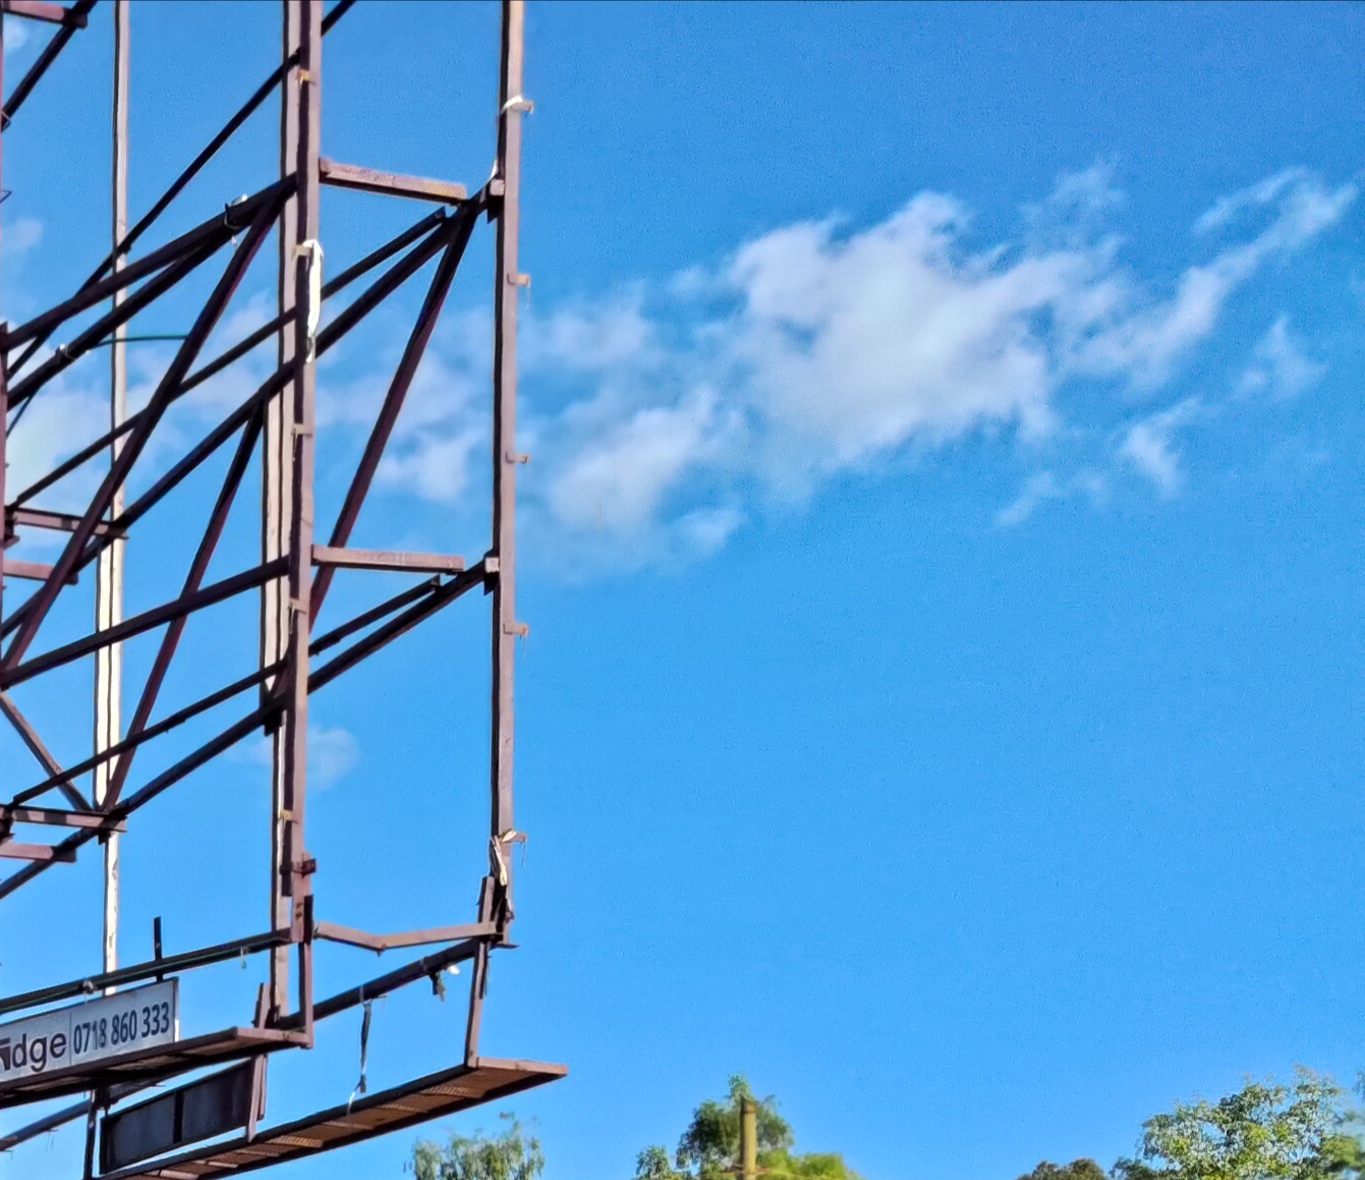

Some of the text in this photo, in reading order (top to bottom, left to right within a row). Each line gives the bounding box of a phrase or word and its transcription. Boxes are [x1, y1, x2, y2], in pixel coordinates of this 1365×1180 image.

[73, 1002, 170, 1055] 0718 860 333
